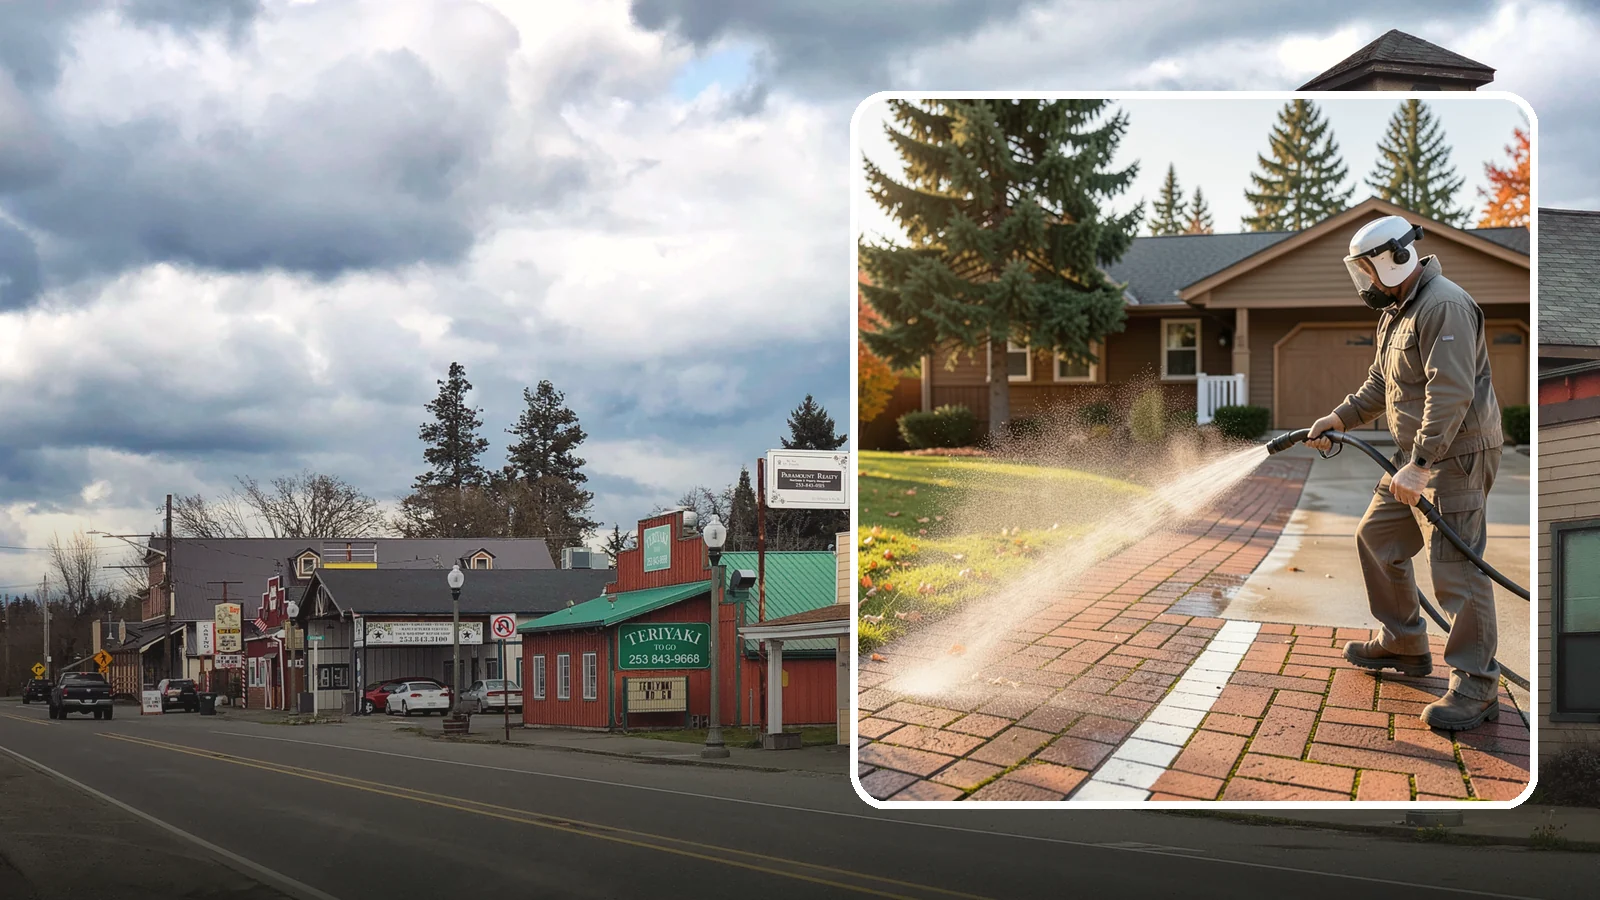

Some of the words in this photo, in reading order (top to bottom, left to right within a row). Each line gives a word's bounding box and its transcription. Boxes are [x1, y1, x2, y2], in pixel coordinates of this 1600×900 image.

[625, 627, 702, 646] TERIYAKI
[654, 643, 664, 651] TO
[665, 643, 677, 651] GO
[629, 654, 649, 665] 253
[651, 654, 700, 664] 843-9668
[639, 681, 673, 690] TERIYAKI
